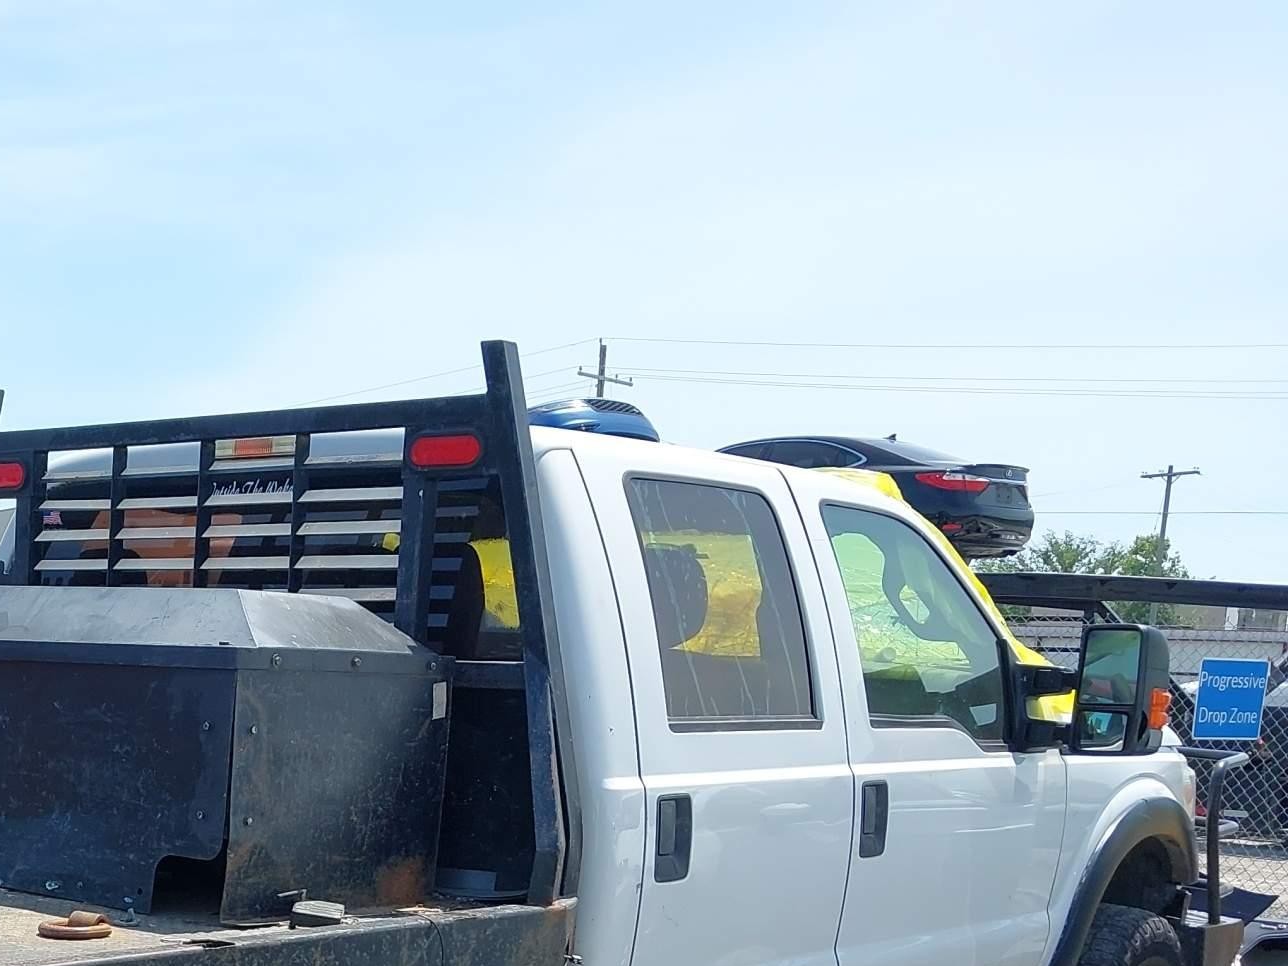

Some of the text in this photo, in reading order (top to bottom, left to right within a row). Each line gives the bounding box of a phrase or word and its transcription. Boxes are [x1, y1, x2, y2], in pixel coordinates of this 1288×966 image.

[242, 478, 263, 495] The
[1200, 671, 1266, 691] Progressive
[1198, 707, 1258, 726] Drop Zone
